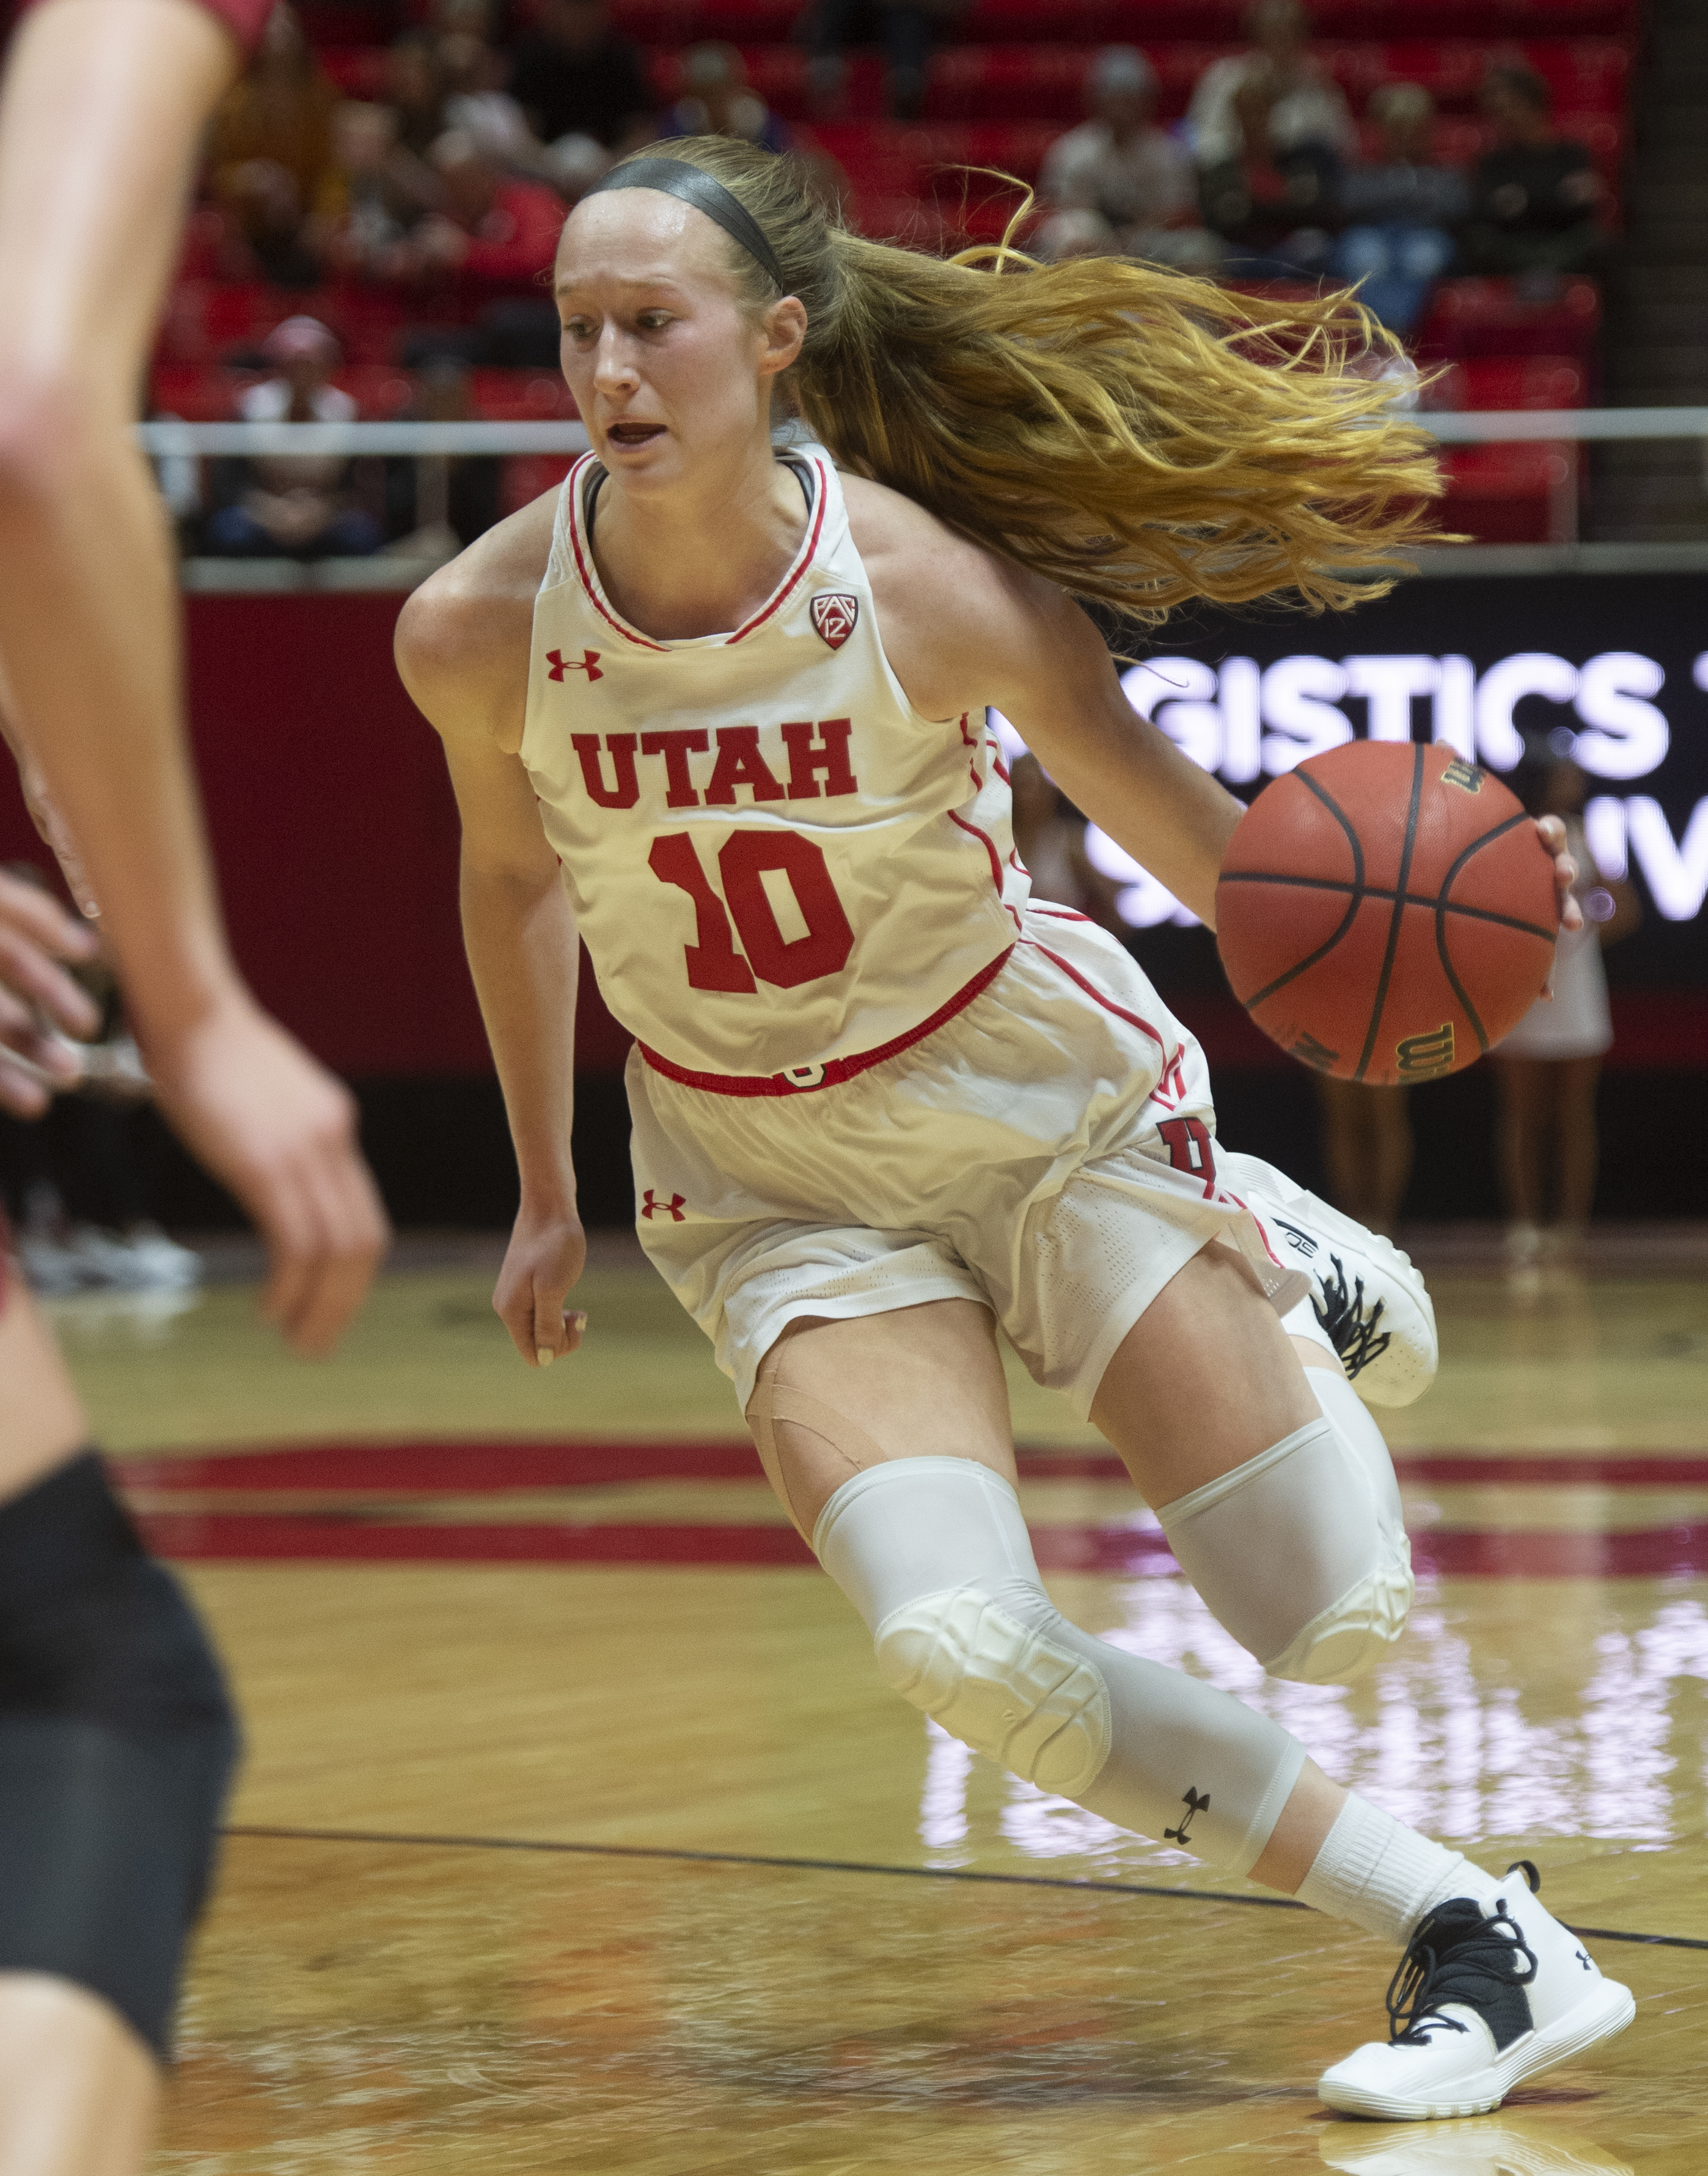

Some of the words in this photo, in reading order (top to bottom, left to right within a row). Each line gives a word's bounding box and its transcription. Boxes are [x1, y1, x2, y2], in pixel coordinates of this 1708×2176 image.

[814, 595, 856, 627] PAC
[825, 618, 846, 639] 12
[570, 718, 859, 809] UTAH
[986, 652, 1671, 784] GISTICS
[648, 829, 856, 994] 10
